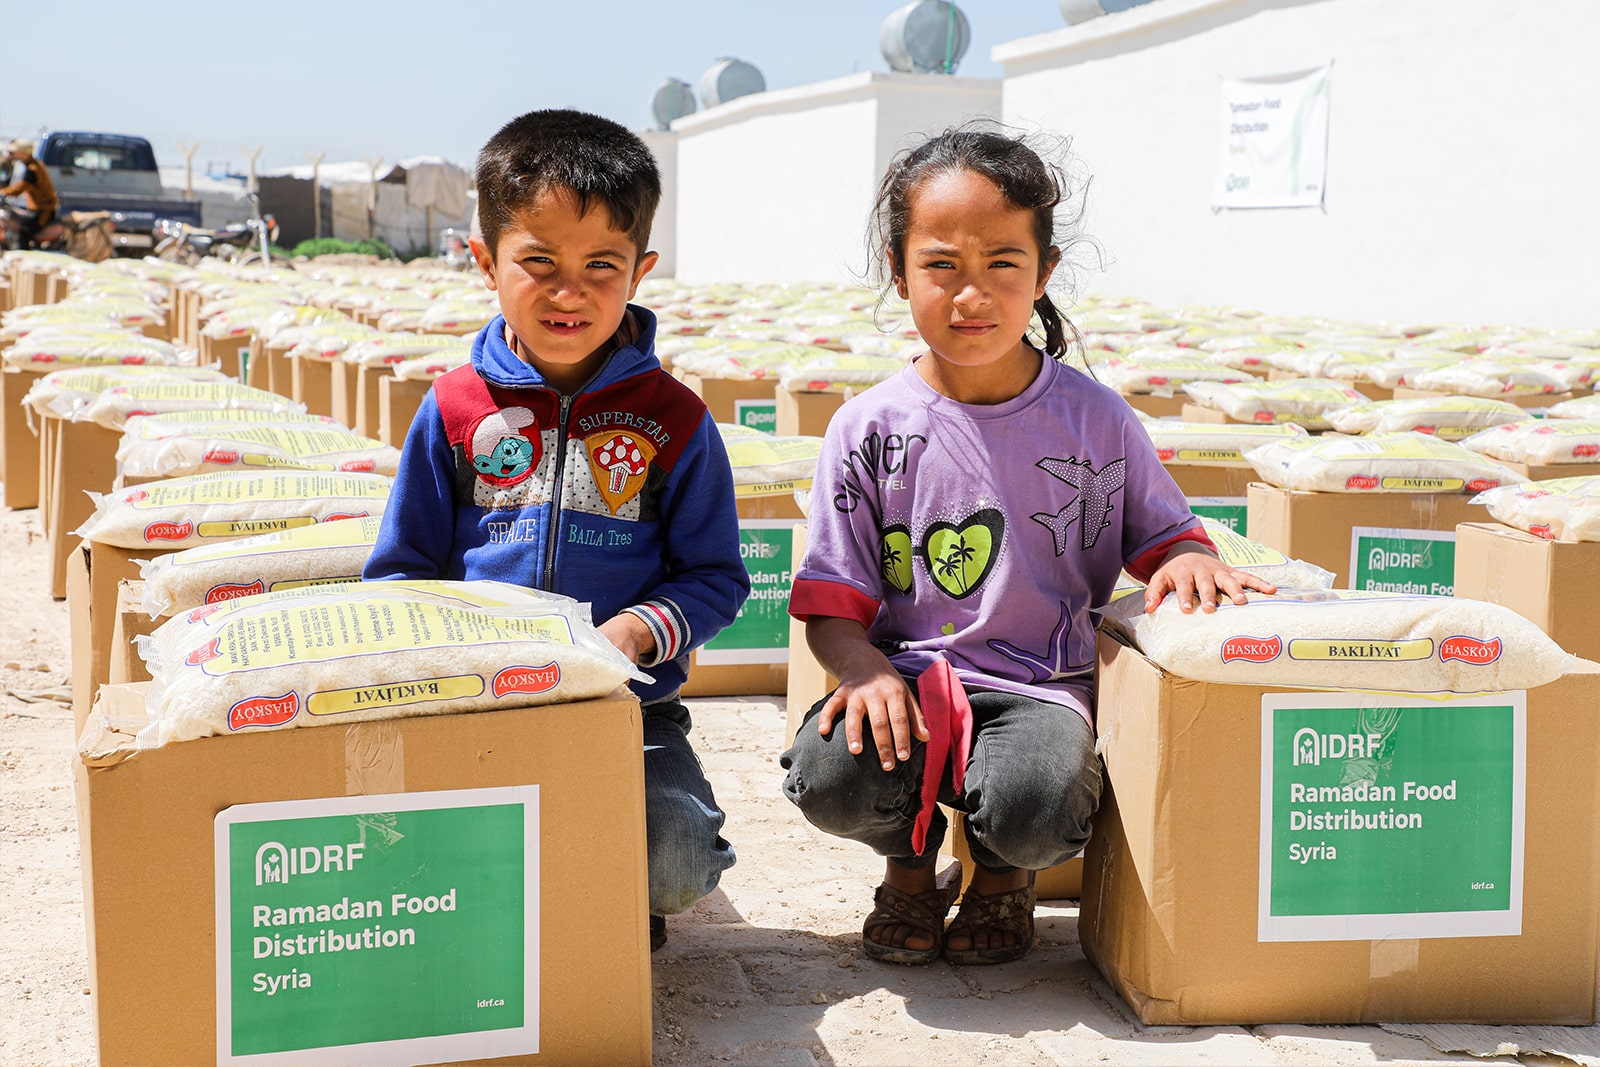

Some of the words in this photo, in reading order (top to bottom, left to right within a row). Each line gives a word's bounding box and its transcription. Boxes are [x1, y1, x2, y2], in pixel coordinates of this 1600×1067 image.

[579, 411, 670, 449] SUPERSTAR
[149, 525, 190, 537] HASKÖY
[228, 520, 287, 533] BAKLİYAT
[568, 523, 603, 546] BAILA
[608, 529, 633, 546] Tres
[740, 543, 770, 558] DRF
[1385, 552, 1422, 568] IDRF
[750, 586, 791, 600] bution
[1366, 579, 1428, 595] Ramadan
[1431, 582, 1455, 596] Foo
[1225, 642, 1278, 656] HASKÖY
[1328, 642, 1402, 658] BAKLİYAT
[1444, 643, 1497, 658] HASKÖY
[498, 669, 556, 689] HASKÖY
[353, 682, 439, 704] BAKLİYAT
[234, 700, 295, 721] HASKÖY
[1321, 734, 1382, 758] IDRF
[1290, 781, 1396, 803] Ramadan
[1403, 780, 1457, 801] Food
[1289, 808, 1423, 831] Distribution
[291, 843, 365, 875] IDRF
[1289, 841, 1338, 865] Syria
[1471, 881, 1495, 890] idrf.ca
[253, 897, 383, 927] Ramadan
[391, 888, 457, 916] Food
[253, 924, 416, 959] Distribution
[252, 967, 312, 996] Syria
[476, 997, 505, 1008] idrf.ca
